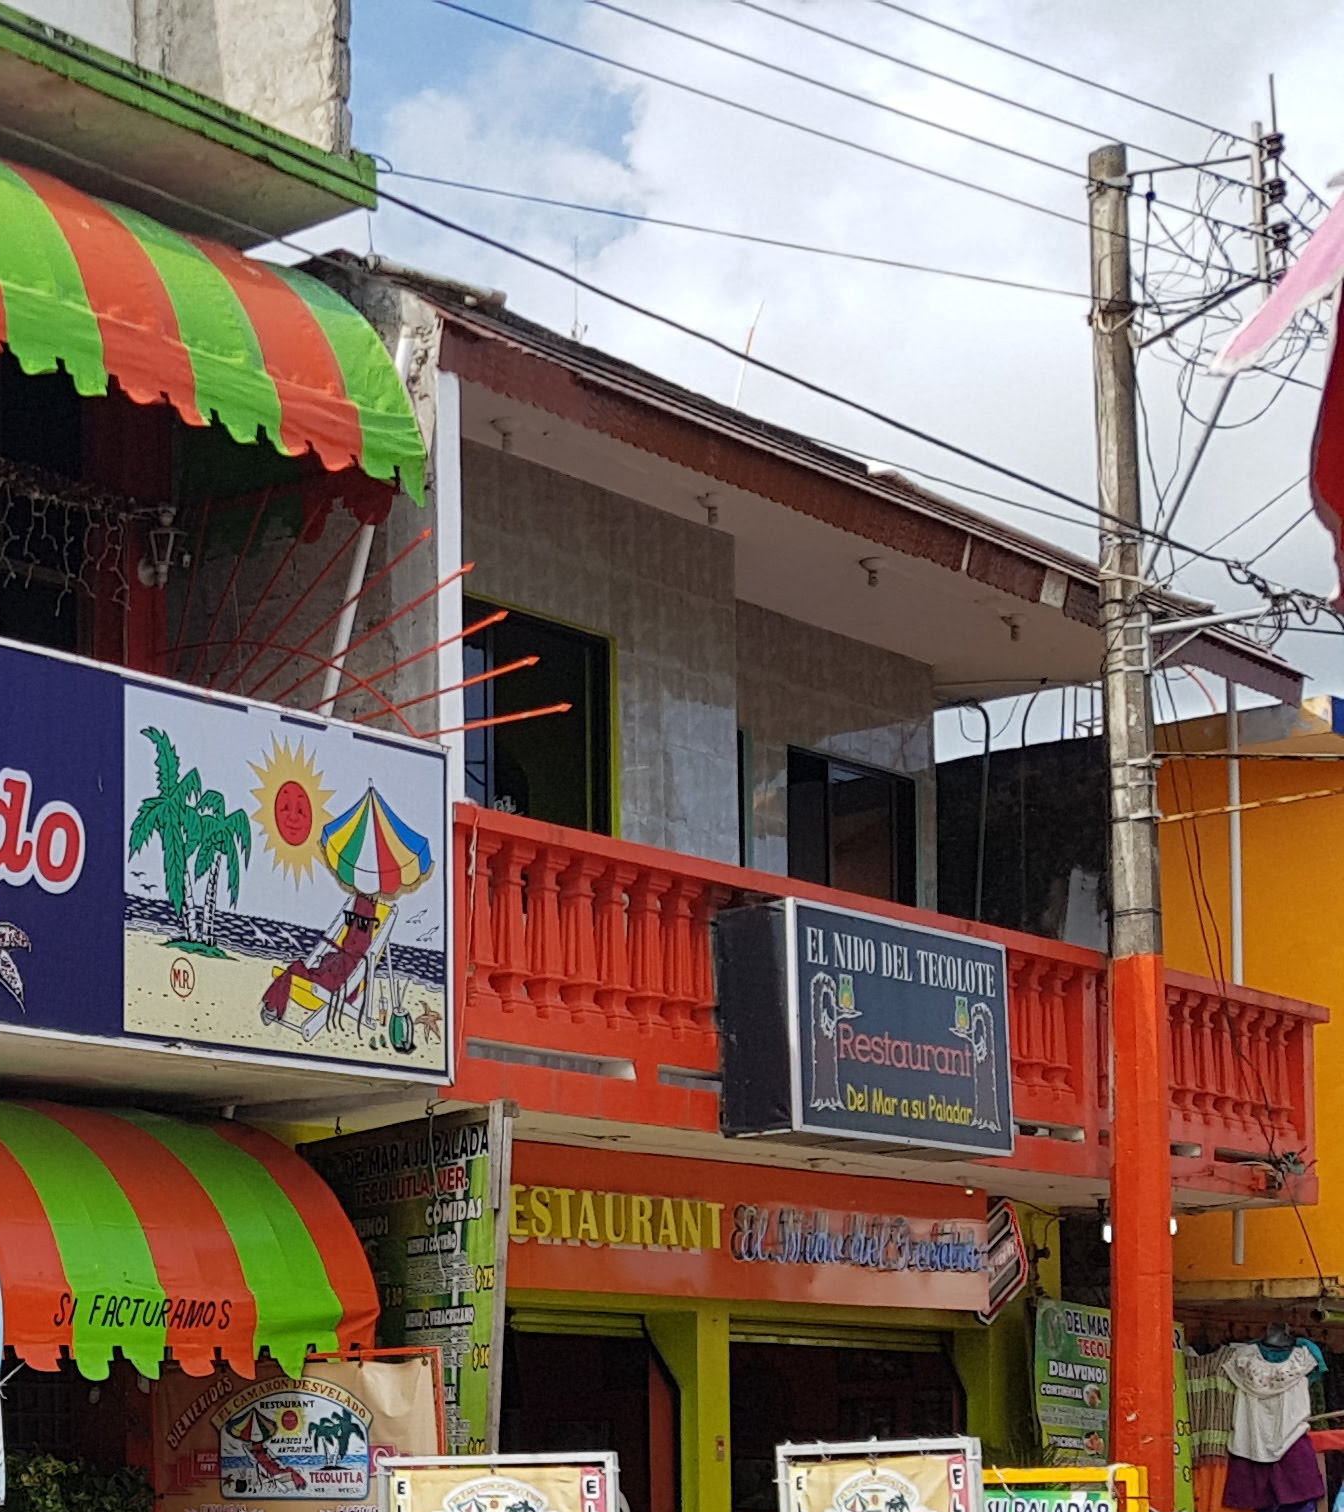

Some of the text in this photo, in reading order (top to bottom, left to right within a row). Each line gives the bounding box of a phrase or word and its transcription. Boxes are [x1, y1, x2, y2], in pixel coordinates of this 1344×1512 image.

[806, 926, 995, 997] EL NIDO DEL TECOLOTE
[839, 1023, 971, 1077] Restaurant
[847, 1083, 972, 1126] Del Mar a su Paladar
[433, 1124, 489, 1162] PALADA
[425, 1199, 482, 1225] COMIDAS
[509, 1185, 725, 1249] ESTAURANT
[54, 1293, 232, 1329] SI FACTURAMOS
[1065, 1309, 1110, 1338] DEL MAR
[294, 1380, 366, 1418] DESVELADO
[309, 1472, 363, 1484] TECOLUTLA
